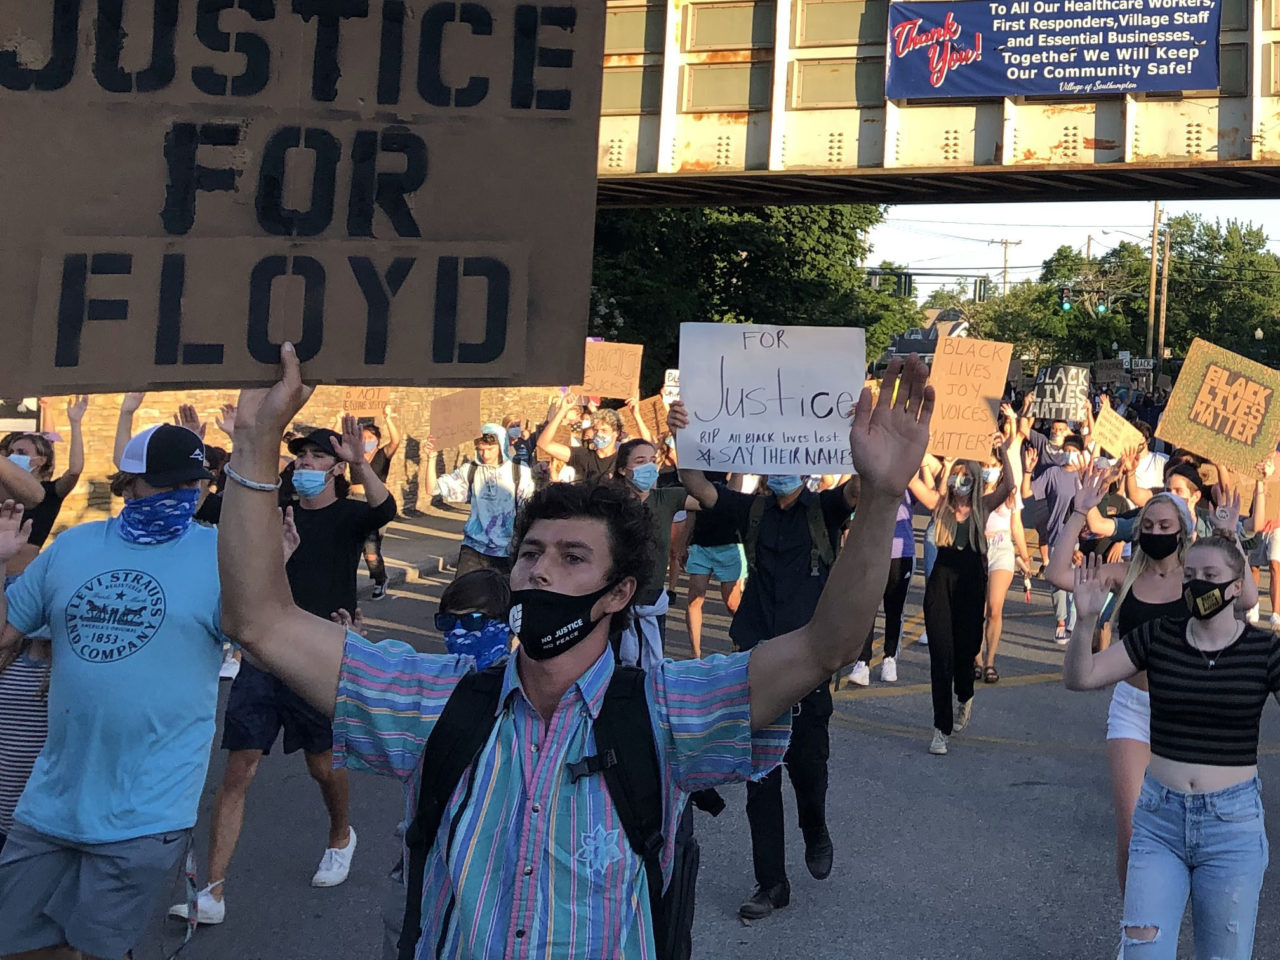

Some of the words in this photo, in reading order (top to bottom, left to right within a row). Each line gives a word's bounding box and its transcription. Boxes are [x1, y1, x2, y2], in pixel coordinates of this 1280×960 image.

[989, 3, 1006, 15] To
[1010, 1, 1029, 14] All
[1033, 1, 1060, 13] Our
[993, 19, 1025, 31] First
[1029, 15, 1118, 32] Responders,
[1119, 13, 1169, 28] Village
[1173, 11, 1210, 24] Staff
[893, 12, 961, 58] Thank
[1007, 34, 1033, 47] and
[1038, 32, 1102, 46] Essential
[1107, 30, 1195, 43] Businesses.
[928, 32, 982, 87] You!
[1002, 50, 1077, 66] Together
[1084, 49, 1109, 61] We
[1116, 47, 1149, 60] Will
[1156, 46, 1199, 61] Keep
[1007, 67, 1037, 79] Our
[1043, 64, 1141, 79] Community
[1147, 62, 1192, 75] Safe!
[1059, 82, 1083, 93] Village
[1084, 82, 1093, 92] of
[1093, 80, 1137, 91] Southampton
[160, 122, 429, 238] FOR
[54, 253, 511, 367] FLOYD
[743, 329, 788, 349] FOR
[943, 339, 1004, 361] BLACK
[949, 362, 991, 379] LIVES
[1036, 367, 1088, 384] BLACK
[694, 356, 853, 422] Justice
[946, 383, 981, 398] JOY
[1034, 384, 1087, 403] LIVES
[1203, 364, 1273, 406] BLACK
[940, 403, 989, 422] VOICES
[1026, 402, 1086, 421] MATTER
[1197, 383, 1265, 425] LIVES
[1190, 401, 1258, 445] MATTER
[700, 428, 720, 443] RIP
[782, 432, 809, 443] lives
[719, 445, 755, 466] SAY
[762, 445, 800, 465] THEIR
[70, 578, 103, 608] LEVI
[110, 572, 162, 617] STRAUSS
[66, 614, 81, 644] AND
[80, 621, 157, 660] COMPANY
[91, 632, 118, 644] 1853
[541, 635, 552, 644] NO
[555, 618, 583, 638] JUSTICE
[556, 630, 579, 646] PEACE
